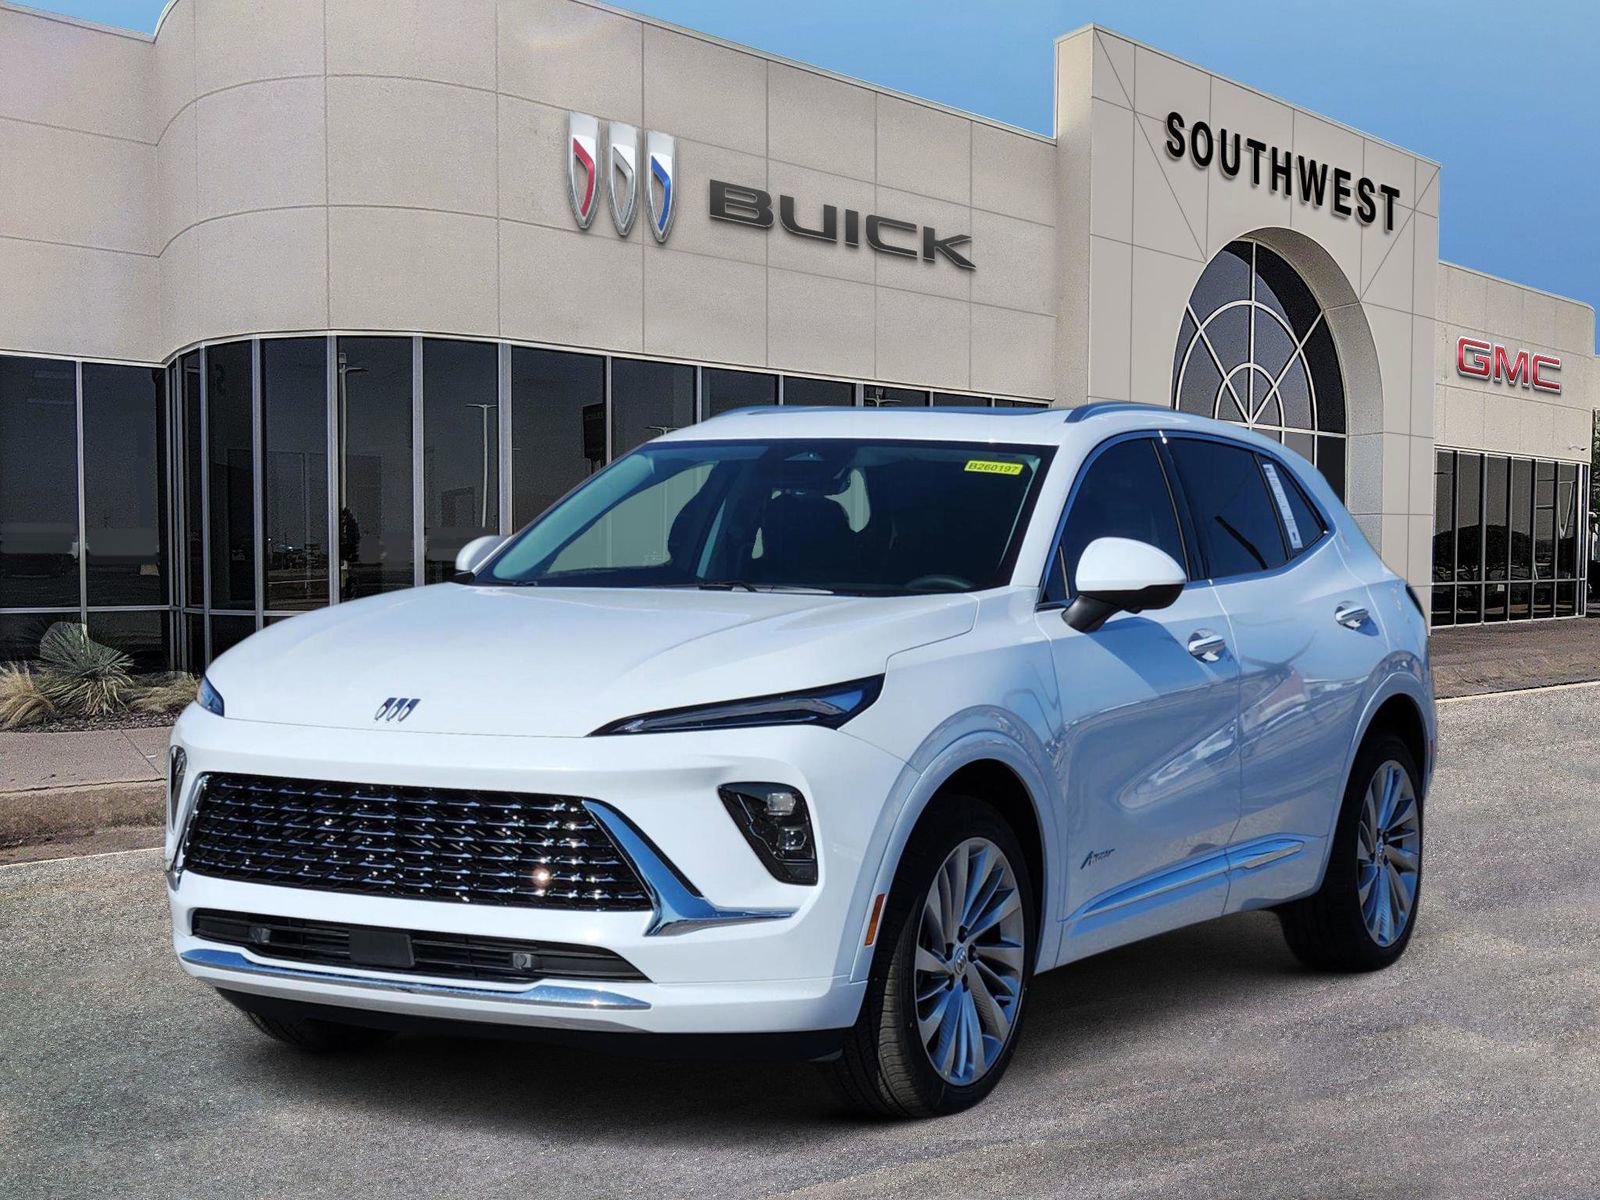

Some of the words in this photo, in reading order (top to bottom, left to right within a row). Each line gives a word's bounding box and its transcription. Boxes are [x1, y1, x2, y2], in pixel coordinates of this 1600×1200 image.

[1166, 111, 1400, 232] SOUTHWEST
[709, 179, 977, 270] BUICK
[1457, 336, 1561, 394] GMC
[967, 462, 1020, 473] B260197
